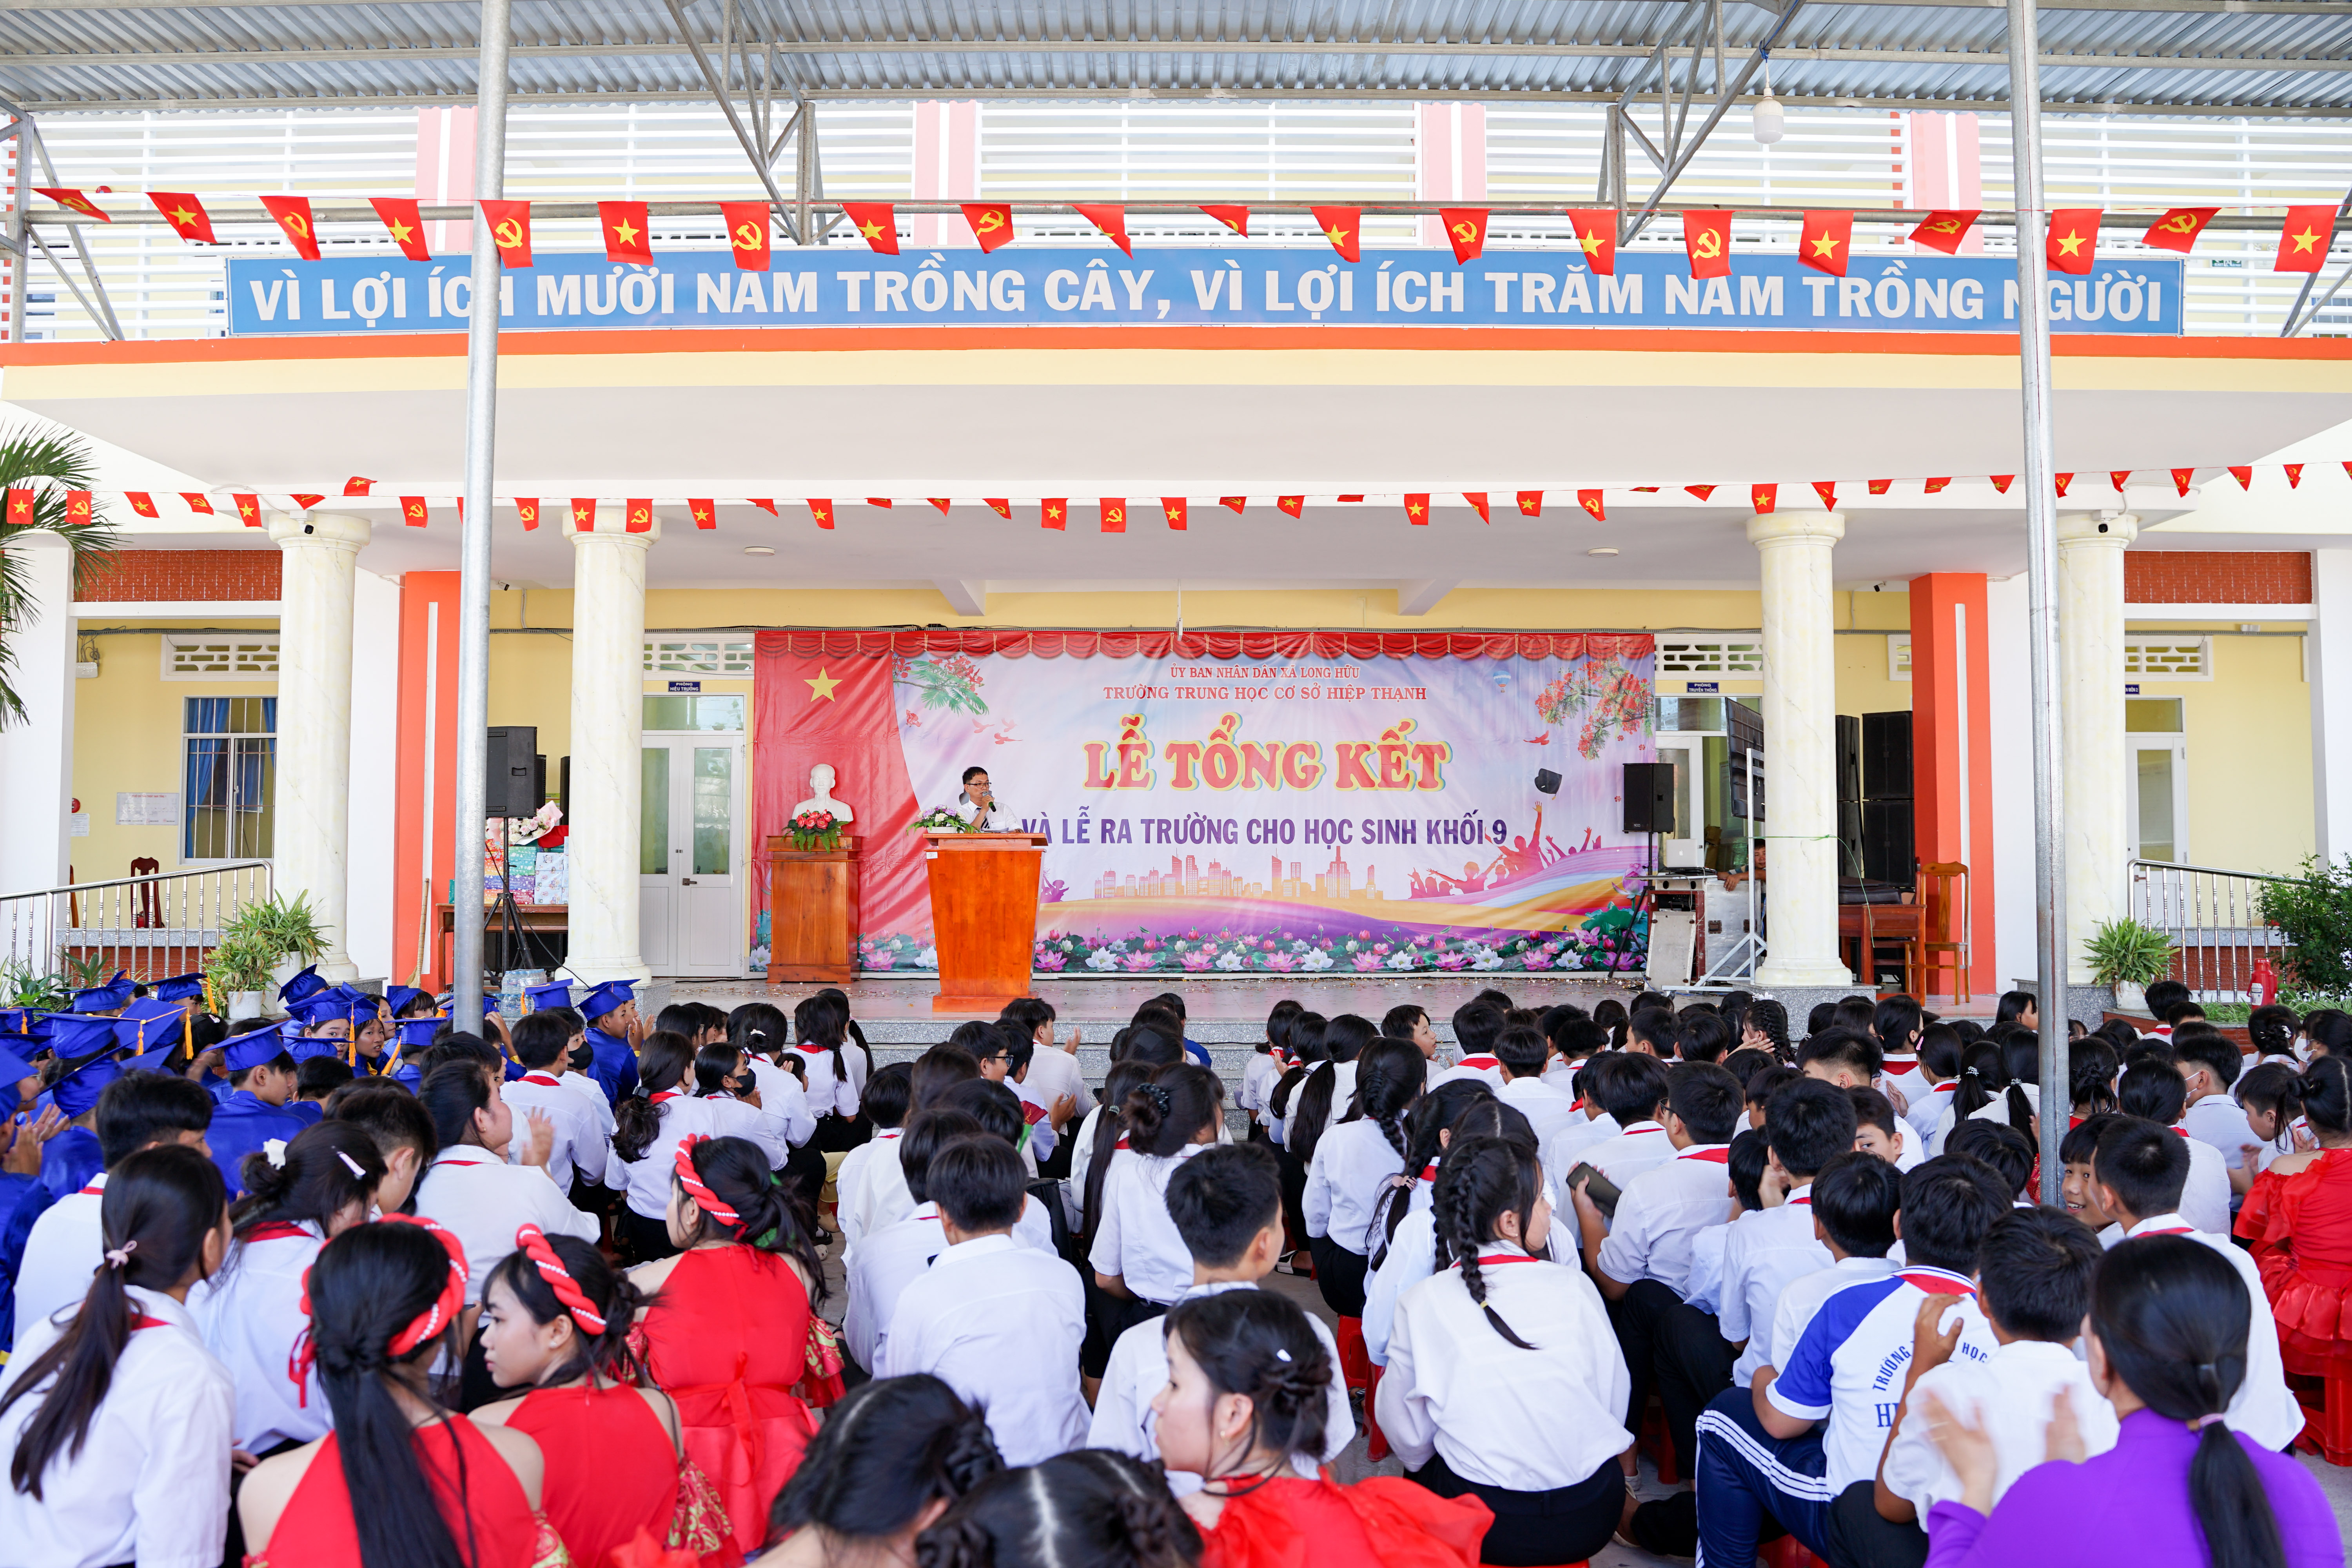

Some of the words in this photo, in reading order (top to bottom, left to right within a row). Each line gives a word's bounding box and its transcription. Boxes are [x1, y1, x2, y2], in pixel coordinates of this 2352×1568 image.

[250, 269, 300, 321] VÌ
[322, 271, 406, 327] LỢI
[537, 263, 674, 316] MƯỜI
[837, 252, 1025, 312] TRỒNG
[1045, 259, 1170, 319] CÂY,
[1191, 260, 1242, 310] VÌ
[1266, 264, 1353, 319] LỢI
[1377, 261, 1464, 312] ÍCH
[1485, 265, 1642, 314] TRĂM
[1802, 260, 1983, 319] TRỒNG
[1103, 684, 1169, 699] TRƯỜNG
[1175, 687, 1229, 699] TRUNG
[1235, 687, 1269, 702] HỌC
[1274, 685, 1295, 699] CƠ
[1301, 682, 1321, 699] SỞ
[1327, 684, 1365, 702] HIỆP
[1370, 688, 1426, 702] THẠNH
[1171, 663, 1186, 677] ỦY
[1190, 668, 1212, 678] BAN
[1217, 665, 1249, 678] NHÂN
[1253, 665, 1277, 678] DÂN
[1280, 665, 1297, 678] XÃ
[1301, 668, 1331, 678] LONG
[1335, 665, 1359, 678] HỮU
[1083, 715, 1152, 789] LỄ
[1164, 713, 1322, 790] TỔNG
[1335, 719, 1448, 790] KẾT
[1062, 806, 1090, 844] LỄ
[1101, 819, 1132, 844] RA
[1141, 812, 1238, 844] TRƯỜNG
[1247, 819, 1295, 844] CHO
[1305, 819, 1353, 849] HỌC
[1361, 819, 1416, 844] SINH
[1426, 809, 1483, 844] KHỐI
[1492, 819, 1507, 844] 9
[1872, 1346, 1912, 1391] TRƯỜNG
